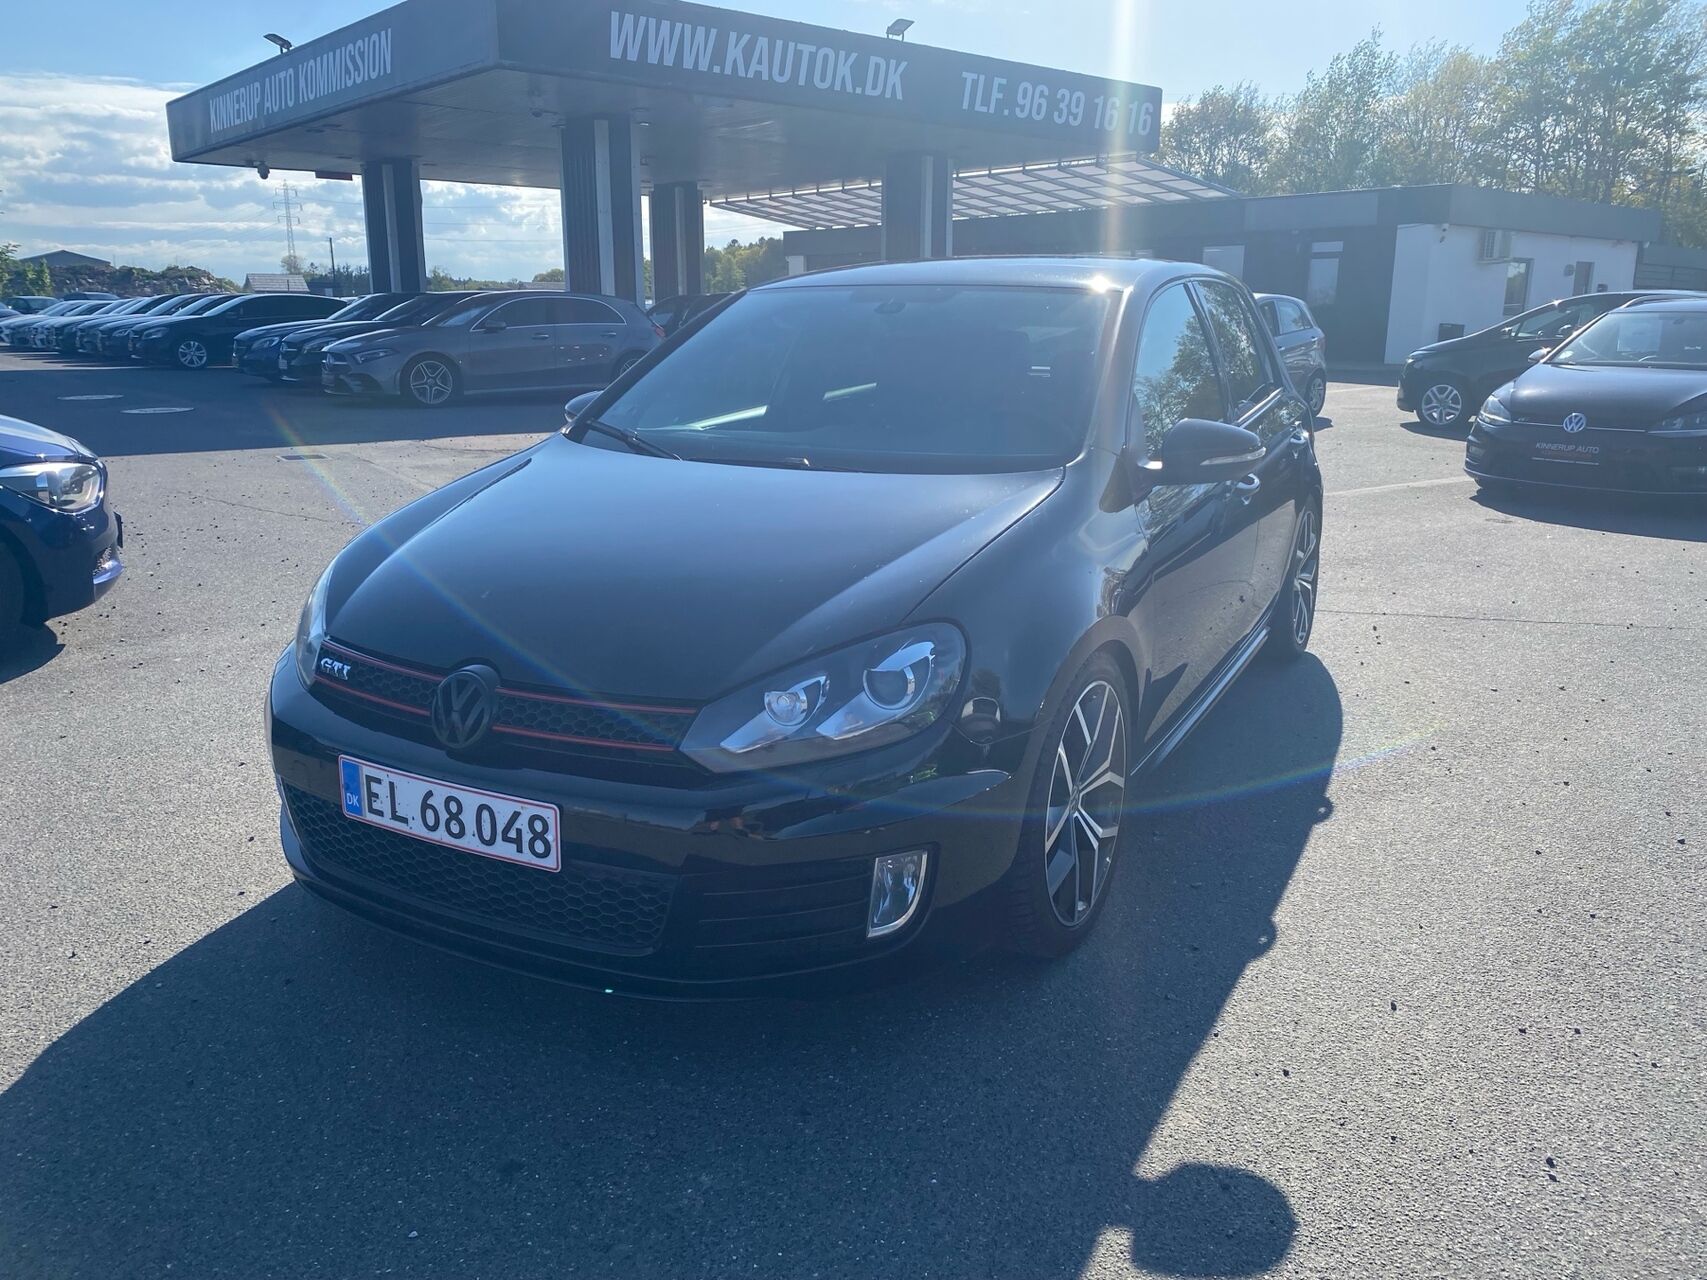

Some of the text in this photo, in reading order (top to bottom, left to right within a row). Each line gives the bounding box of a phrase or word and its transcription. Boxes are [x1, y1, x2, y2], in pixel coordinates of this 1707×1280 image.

[209, 28, 392, 133] KINNERUP AUTO KOMMISSION
[609, 11, 908, 100] WWW.KAUTOK.DK
[961, 71, 1154, 136] TLF. 96 39 16 16
[1535, 441, 1600, 454] KINNERUP AUTO
[320, 657, 351, 681] GTI
[346, 792, 359, 808] DK
[365, 774, 552, 859] EL 68 048
